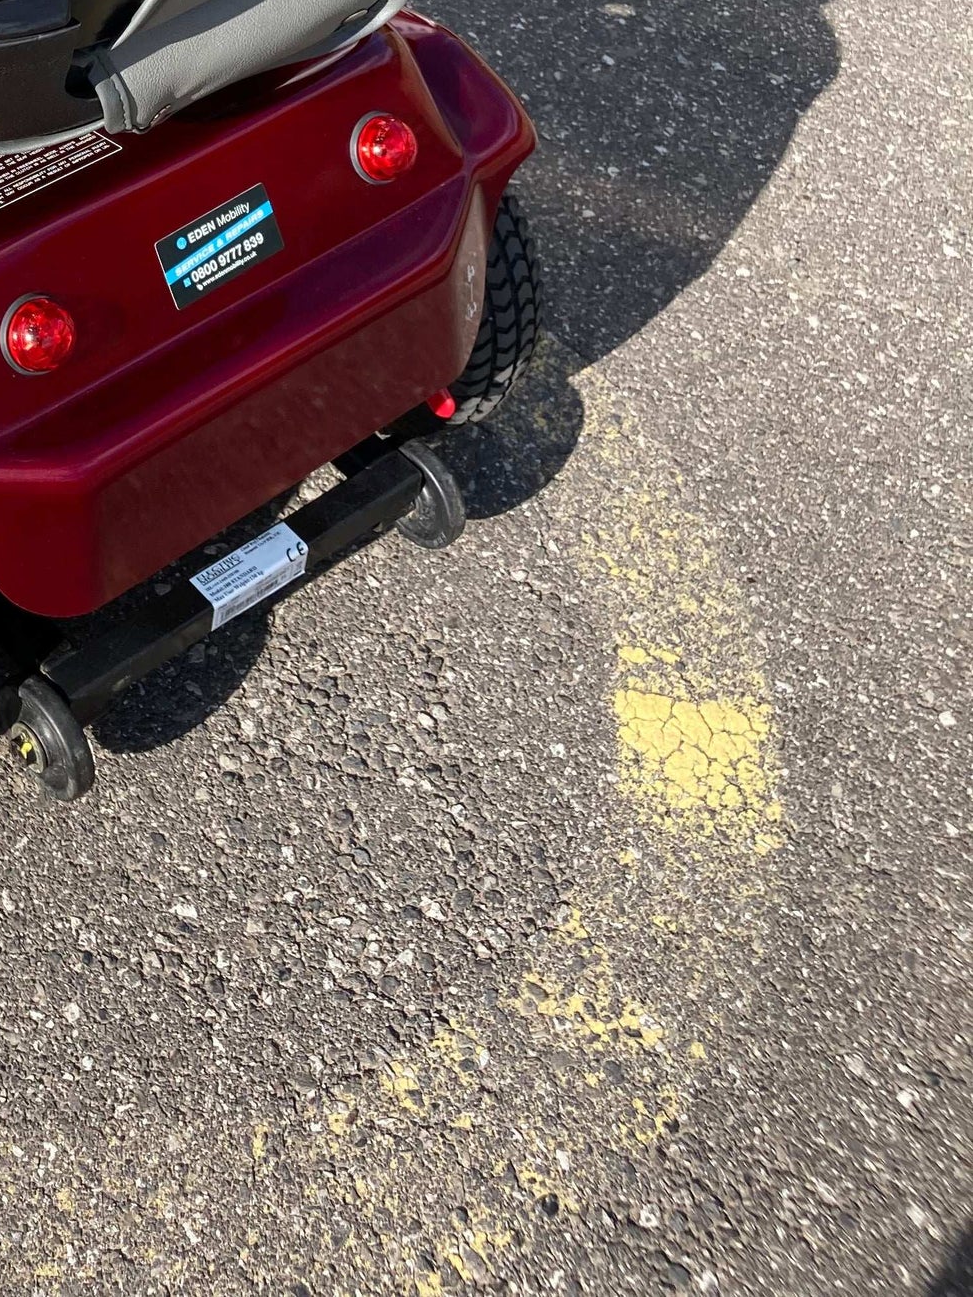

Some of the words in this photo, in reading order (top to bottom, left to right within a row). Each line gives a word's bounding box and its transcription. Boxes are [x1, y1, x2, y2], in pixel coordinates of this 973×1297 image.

[175, 243, 215, 277] SERVICE
[216, 237, 224, 248] &
[225, 209, 264, 241] REPAIRS
[187, 220, 216, 244] EDEN
[215, 202, 250, 228] Mobility
[191, 259, 218, 283] 0800
[217, 244, 242, 267] 9777
[242, 232, 264, 252] 839
